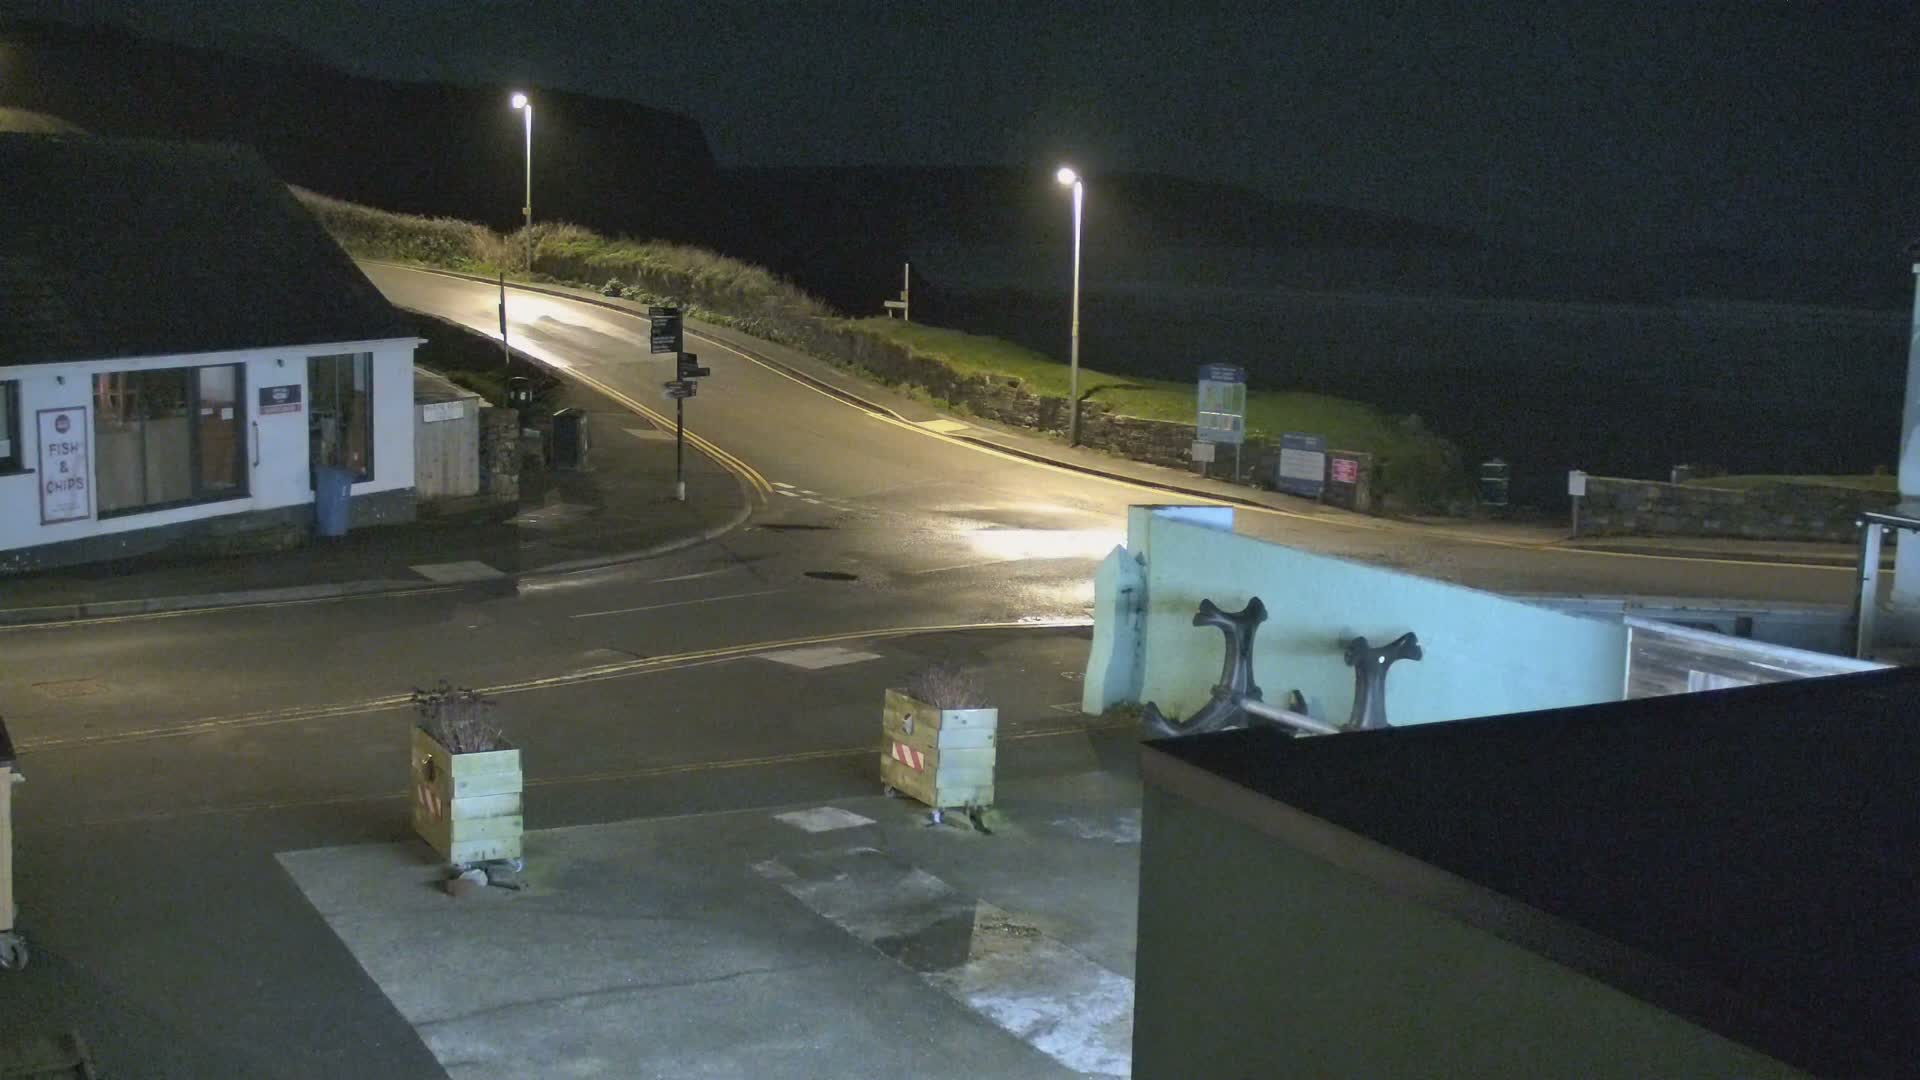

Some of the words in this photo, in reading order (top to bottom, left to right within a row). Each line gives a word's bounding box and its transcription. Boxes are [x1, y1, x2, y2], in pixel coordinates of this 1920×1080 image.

[49, 442, 79, 456] FISH
[60, 461, 69, 473] &
[46, 477, 84, 494] CHIPS
